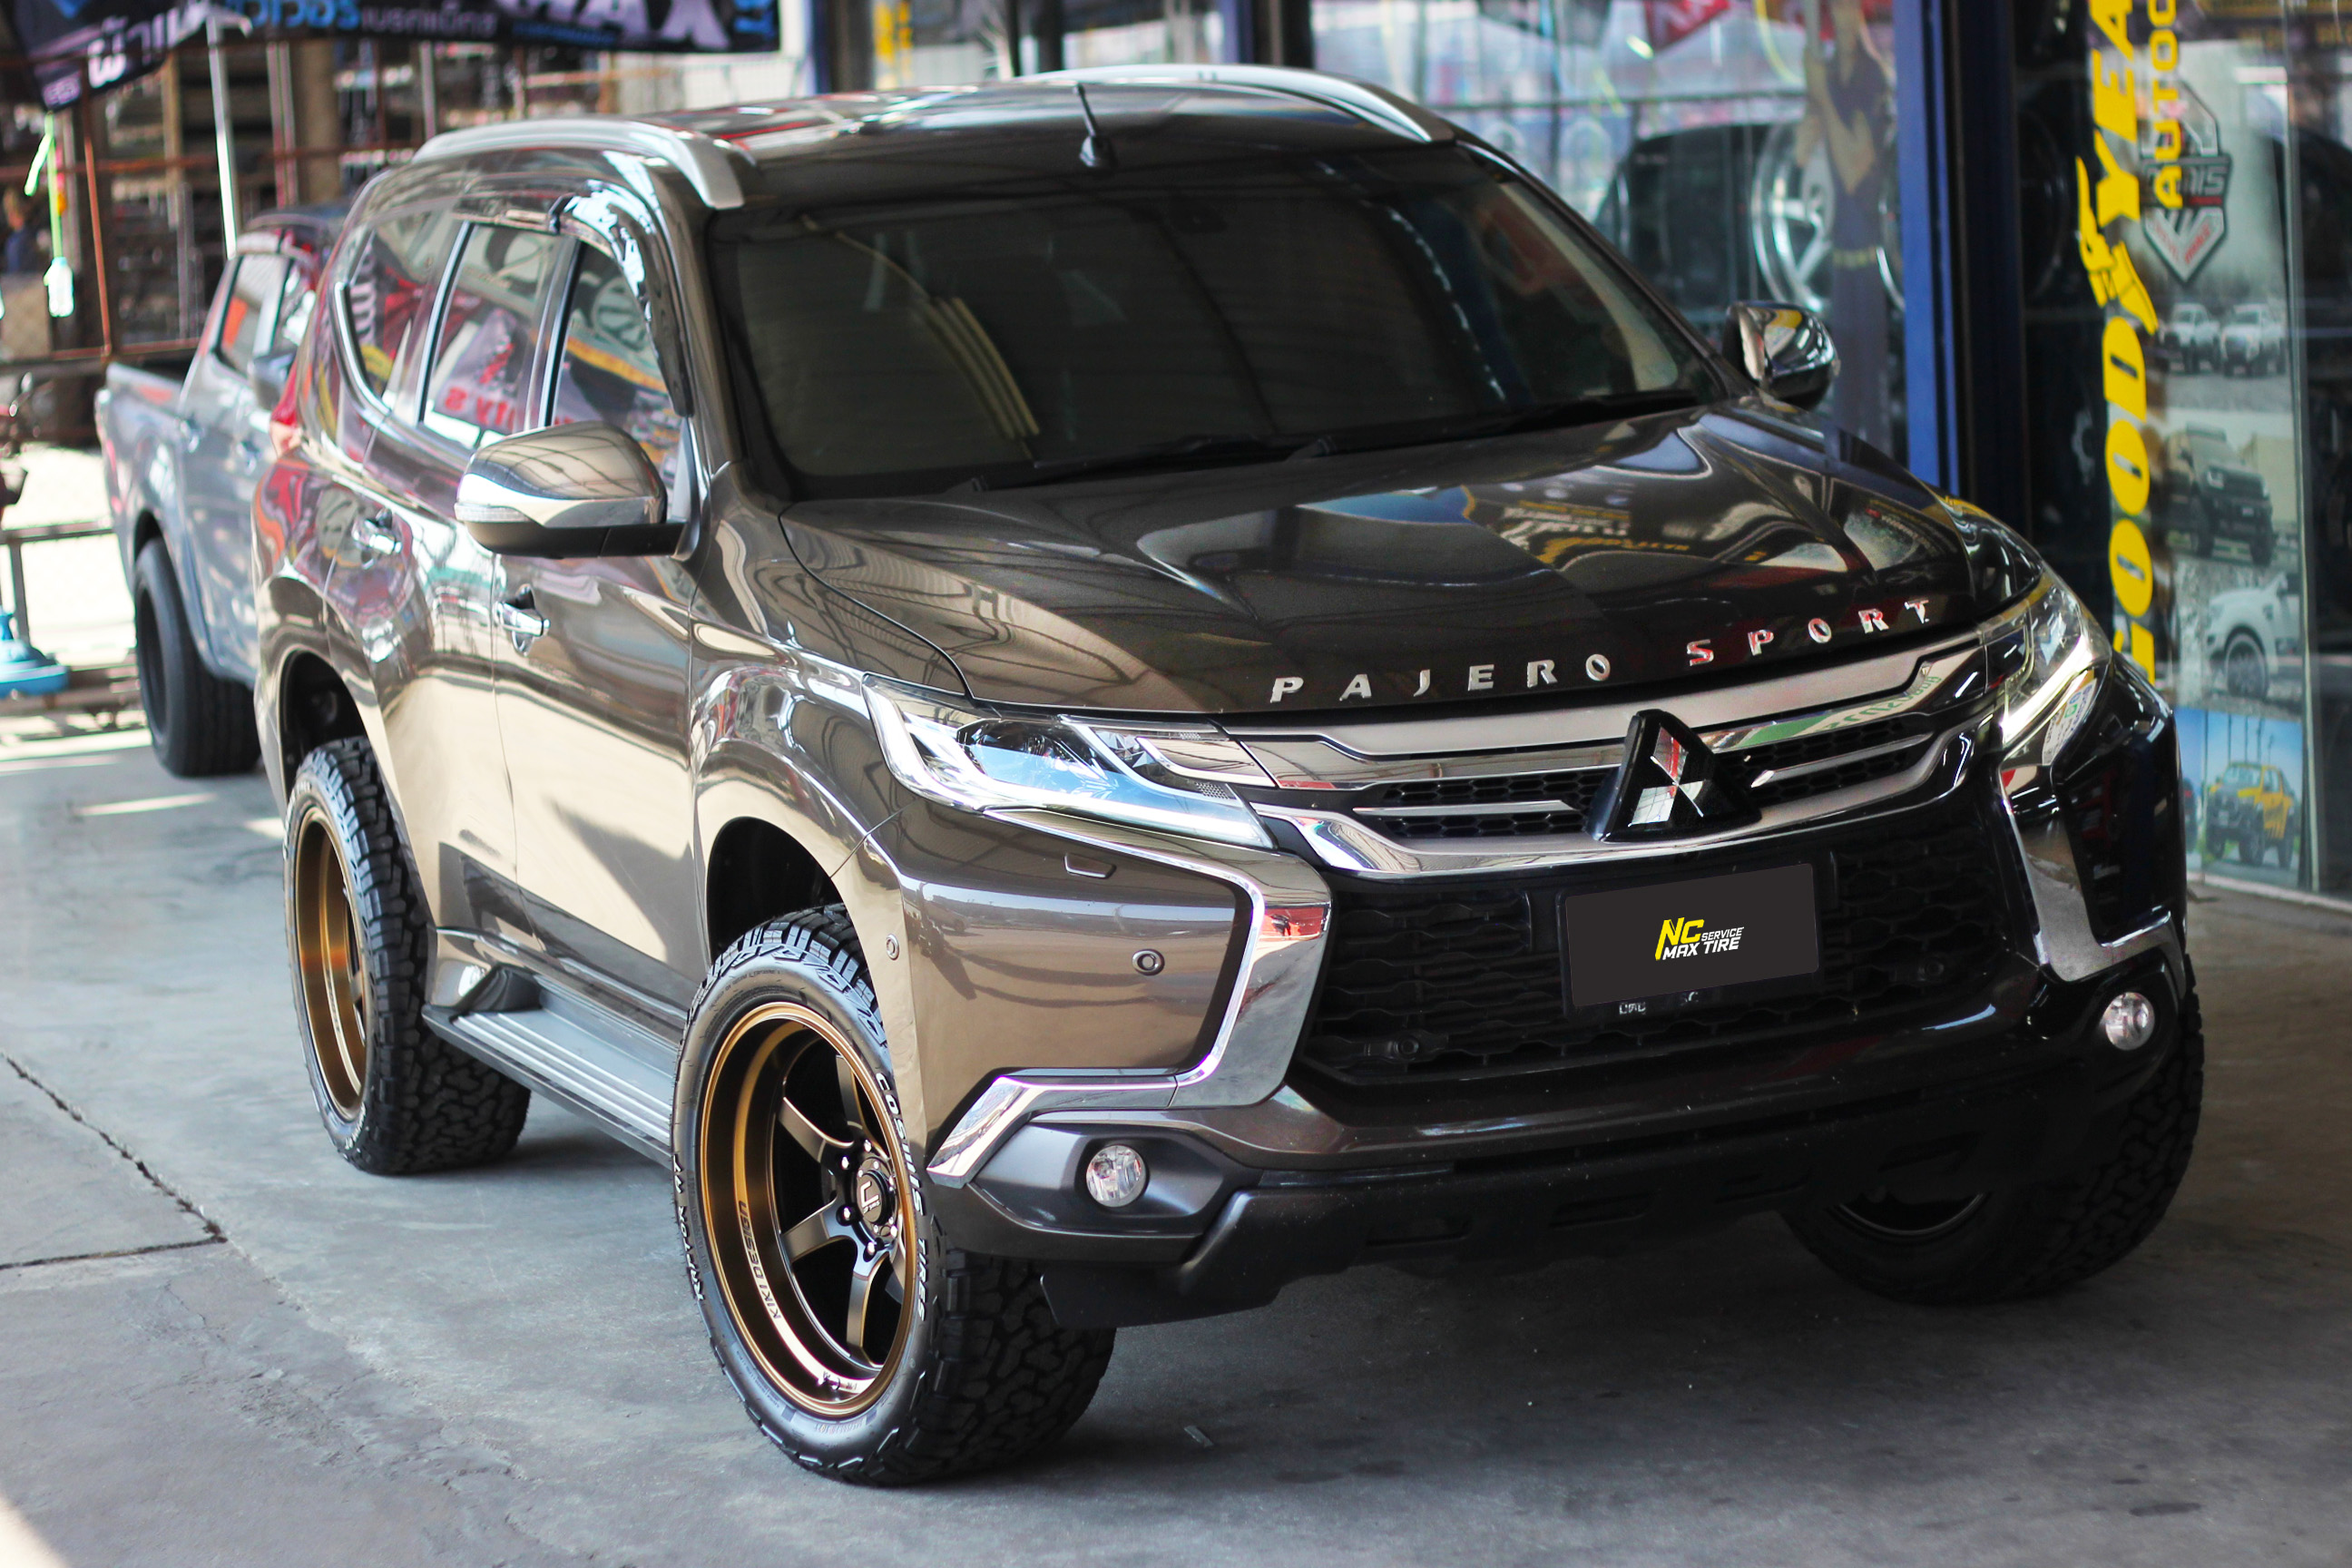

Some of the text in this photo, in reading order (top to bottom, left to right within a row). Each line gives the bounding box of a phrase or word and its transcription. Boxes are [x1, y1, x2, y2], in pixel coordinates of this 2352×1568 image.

[1270, 599, 1929, 703] PAJERO SPORT
[876, 1073, 929, 1321] COSMIS TIRES
[678, 1206, 705, 1300] RAPTOR
[738, 1200, 781, 1318] KIKI DESIGN
